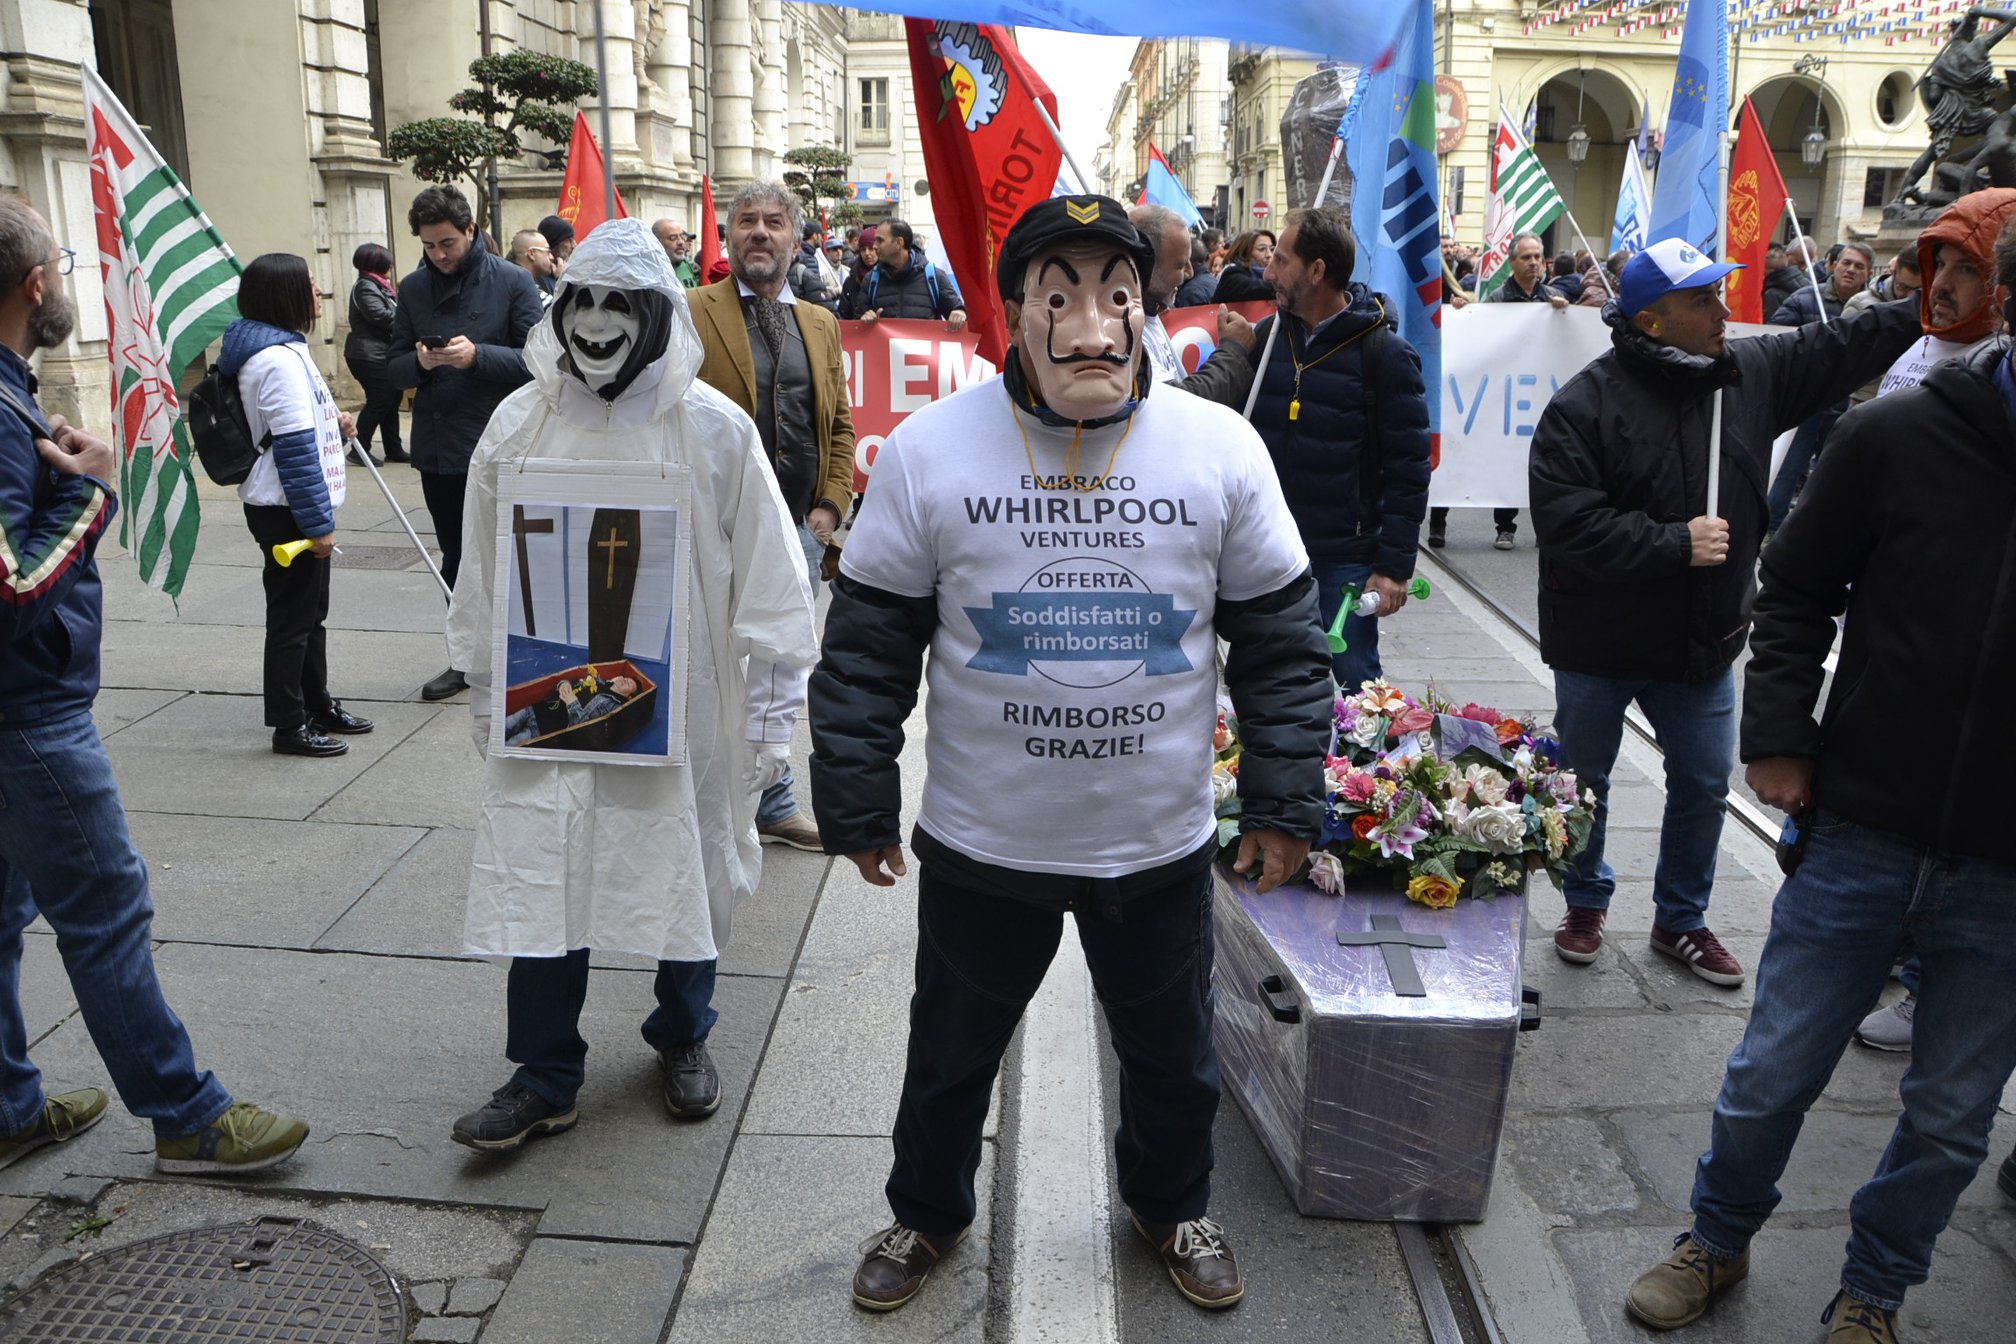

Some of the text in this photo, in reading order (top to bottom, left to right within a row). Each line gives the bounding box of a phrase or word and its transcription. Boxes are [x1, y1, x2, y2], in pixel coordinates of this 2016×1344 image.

[1020, 474, 1137, 492] EMBRACO
[964, 497, 1198, 527] WHIRLPOOL
[1020, 531, 1146, 549] VENTURES
[1038, 571, 1134, 589] OFFERTA
[1008, 606, 1162, 626] Soddisfatti o
[1023, 631, 1149, 651] rimborsati
[1003, 701, 1166, 729] RIMBORSO
[1024, 734, 1145, 759] GRAZIE!
